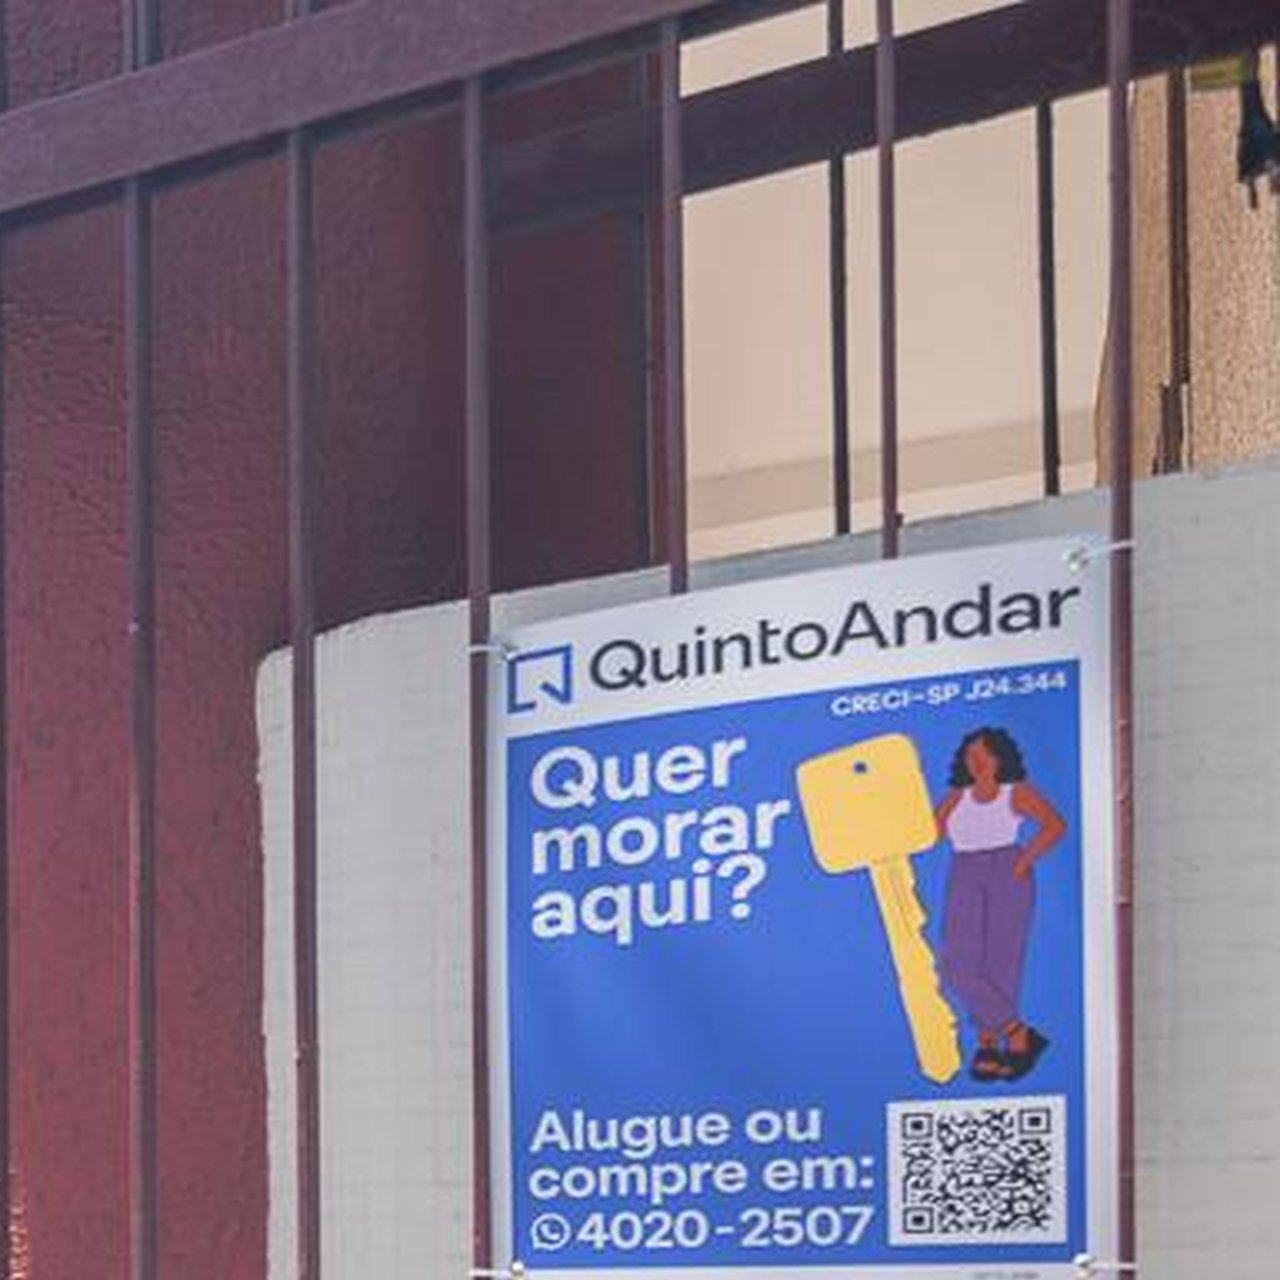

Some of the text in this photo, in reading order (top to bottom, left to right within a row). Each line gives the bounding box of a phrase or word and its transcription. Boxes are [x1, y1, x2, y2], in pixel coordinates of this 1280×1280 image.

[590, 584, 1080, 691] QuintoAndar
[831, 671, 1068, 717] CRECI-SP J24.344
[530, 734, 746, 810] Quer
[531, 799, 790, 874] morar
[530, 858, 767, 944] aqui?
[530, 1110, 822, 1158] Alugue ou
[529, 1154, 874, 1203] compre em:
